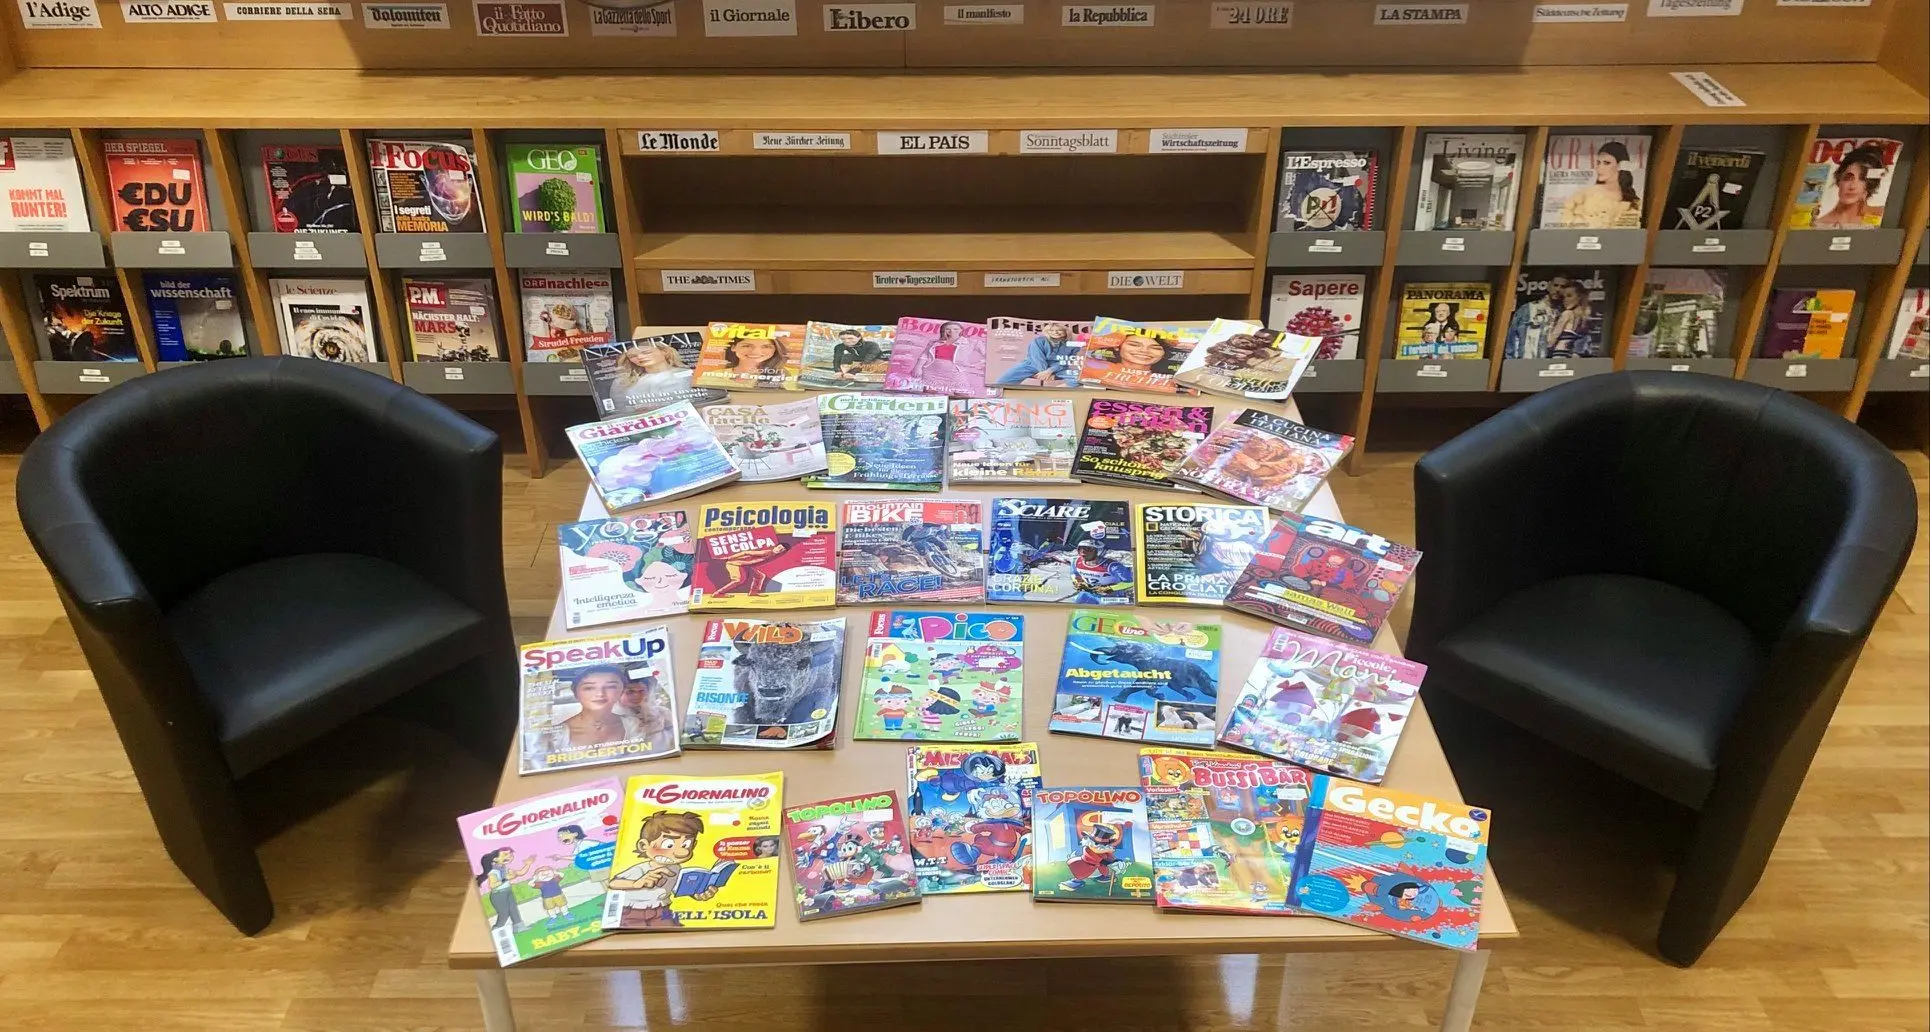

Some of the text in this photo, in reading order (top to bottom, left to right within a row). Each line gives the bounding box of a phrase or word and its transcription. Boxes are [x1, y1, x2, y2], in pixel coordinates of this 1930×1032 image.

[27, 2, 91, 21] l'Adige
[129, 4, 210, 16] ALTO ADIGE
[236, 6, 342, 15] CORRIERE DELLA SERA
[371, 7, 442, 22] Dolomiten
[494, 4, 546, 21] il Fatto
[651, 9, 672, 26] Sport
[709, 9, 790, 22] il Giornale
[829, 8, 910, 29] Libero
[957, 8, 1012, 18] il manifesto
[1069, 8, 1148, 25] la Repubblica
[1228, 6, 1289, 23] 24 ORE
[1380, 8, 1461, 19] LA STAMPA
[482, 16, 562, 35] Quotidiano
[104, 142, 168, 153] DER SPIEGEL
[641, 131, 719, 149] Le Monde
[763, 135, 845, 147] Neue Zürcher Zeitung
[900, 136, 926, 149] EL
[1026, 134, 1110, 151] Sonntagsblatt
[1162, 139, 1239, 149] Wirtschaftszeitung
[383, 141, 473, 172] Focus
[527, 149, 578, 171] GEO
[1442, 140, 1511, 164] Living
[1285, 156, 1368, 173] L'Espresso
[9, 189, 65, 201] KOMMT MAL
[11, 202, 68, 218] RUNTER!
[399, 206, 431, 216] segreti
[522, 210, 560, 222] WIRD'S
[397, 221, 449, 232] MEMORIA
[160, 281, 191, 289] bild der
[666, 276, 751, 284] THE TIMES
[875, 275, 955, 286] Tiroler Tageszeitung
[1110, 275, 1182, 286] DIE WELT
[51, 284, 110, 300] Spektrum
[151, 287, 232, 299] wissenschaft
[410, 287, 445, 305] P.M.
[1288, 281, 1359, 299] Sapere
[1406, 290, 1486, 301] PANORAMA
[414, 321, 457, 334] MARS
[538, 335, 604, 347] Strudel Freuden
[584, 332, 692, 361] NATURAL
[707, 407, 767, 416] CASA
[827, 394, 937, 412] Garten
[1092, 401, 1209, 420] essen &
[579, 409, 689, 441] Giardino
[1250, 411, 1332, 441] LA CUCINA
[1250, 418, 1321, 446] ITALIANA
[952, 468, 1008, 477] kleine
[704, 505, 829, 530] Psicologia
[850, 507, 924, 524] BIKE
[1145, 506, 1263, 527] STORICA
[570, 515, 677, 552] yoga
[709, 531, 753, 547] SENSI
[1305, 519, 1392, 557] art
[712, 537, 776, 556] DI COLPA
[1147, 572, 1229, 584] LA PRIMA
[858, 574, 944, 600] RACE!
[1147, 582, 1230, 594] CROCIAT
[573, 592, 636, 606] Intelligenza
[596, 599, 638, 609] emotiva
[707, 622, 719, 641] Focus
[873, 613, 887, 635] Focus
[918, 612, 1018, 644] Pico
[723, 621, 804, 645] WILD
[524, 637, 666, 670] SpeakUp
[1344, 651, 1391, 672] Piccole
[1065, 668, 1173, 681] Abgetaucht
[697, 692, 749, 704] BISONTE
[546, 741, 653, 764] BRIDGERTON
[1192, 764, 1308, 789] BUSSI BÄR
[642, 784, 770, 805] IL GIORNALINO
[1036, 790, 1142, 804] TOPOLINO
[482, 793, 610, 836] IL GIORNALINO
[787, 795, 893, 823] TOPOLINO
[1329, 785, 1482, 839] Gecko
